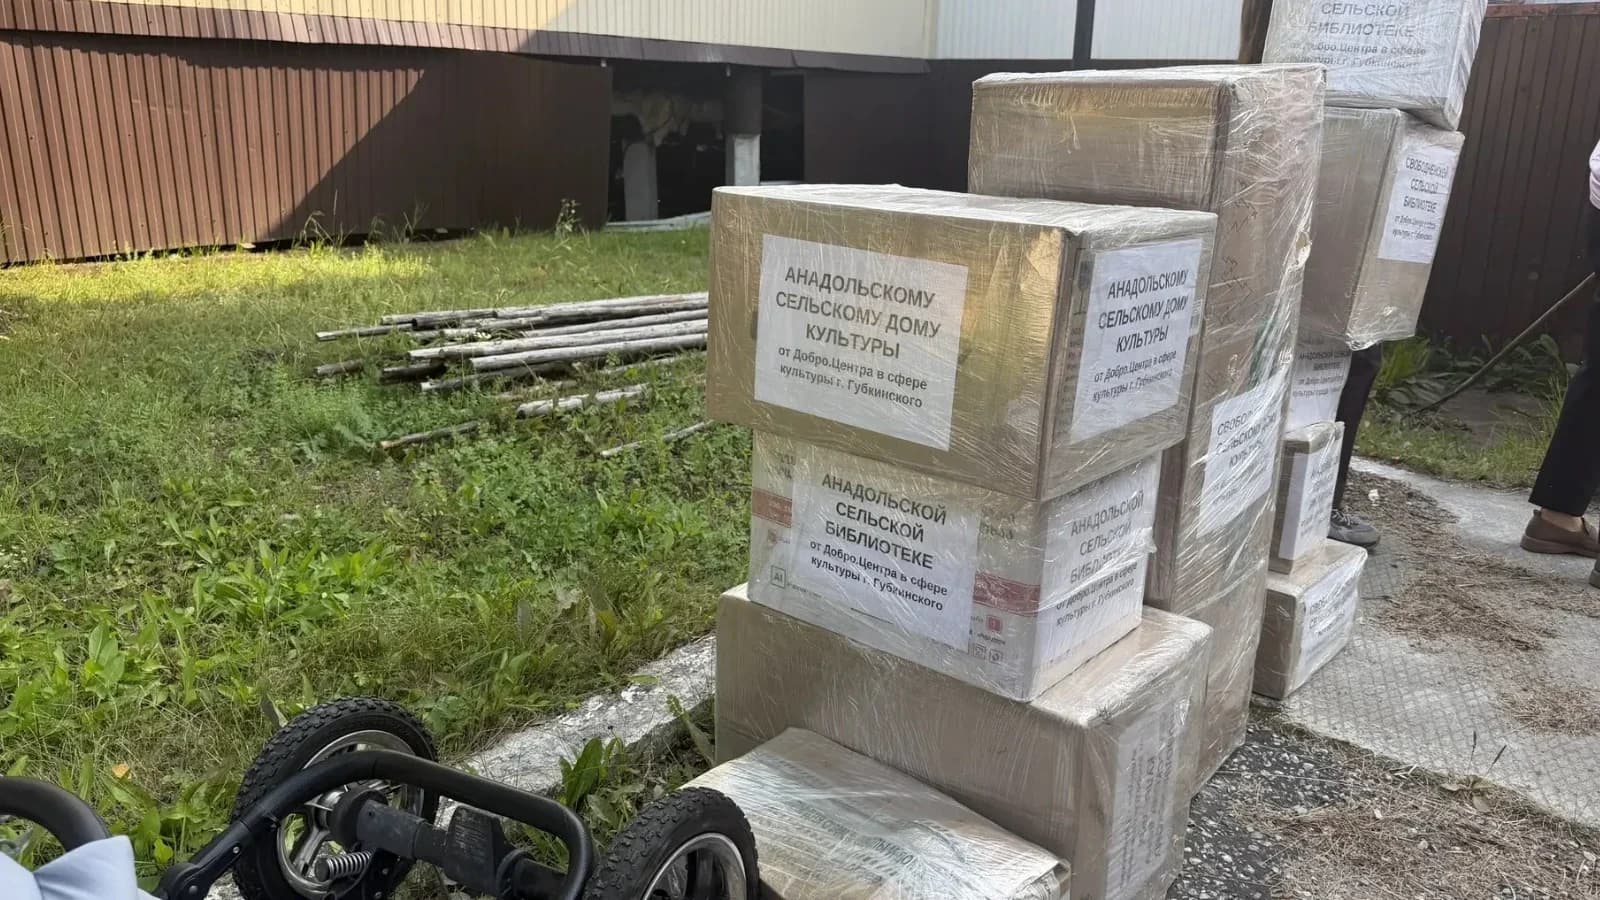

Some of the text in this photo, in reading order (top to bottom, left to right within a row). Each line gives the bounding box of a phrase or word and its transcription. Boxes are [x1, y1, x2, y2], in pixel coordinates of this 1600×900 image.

[1307, 21, 1416, 38] БИБЛИОТЕКЕ
[1321, 2, 1409, 17] СЕЛЬСКОЙ
[785, 266, 936, 309] АНАДОЛЬСКОМУ
[1107, 268, 1190, 300] АНАДОЛЬСКОМУ
[775, 291, 942, 339] СЕЛЬСКОМУ ДОМУ
[1098, 295, 1190, 330] СЕЛЬСКОМУ ДОМУ
[806, 323, 900, 359] КУЛЬТУРЫ
[1116, 325, 1169, 353] КУЛЬТУРЫ
[778, 346, 928, 391] от Добро.Центра в сфере
[780, 365, 923, 408] культуры г. Губкинского
[821, 473, 947, 526] АНАДОЛЬСКОЙ
[1070, 490, 1145, 537] АНАДОЛЬСКОЙ
[836, 501, 925, 543] СЕЛЬСКОЙ
[1079, 519, 1132, 556] СЕЛЬСКОЙ
[825, 520, 934, 570] БИБЛИОТЕКЕ
[809, 541, 821, 550] от
[910, 574, 948, 597] сфере
[811, 556, 861, 582] культуры
